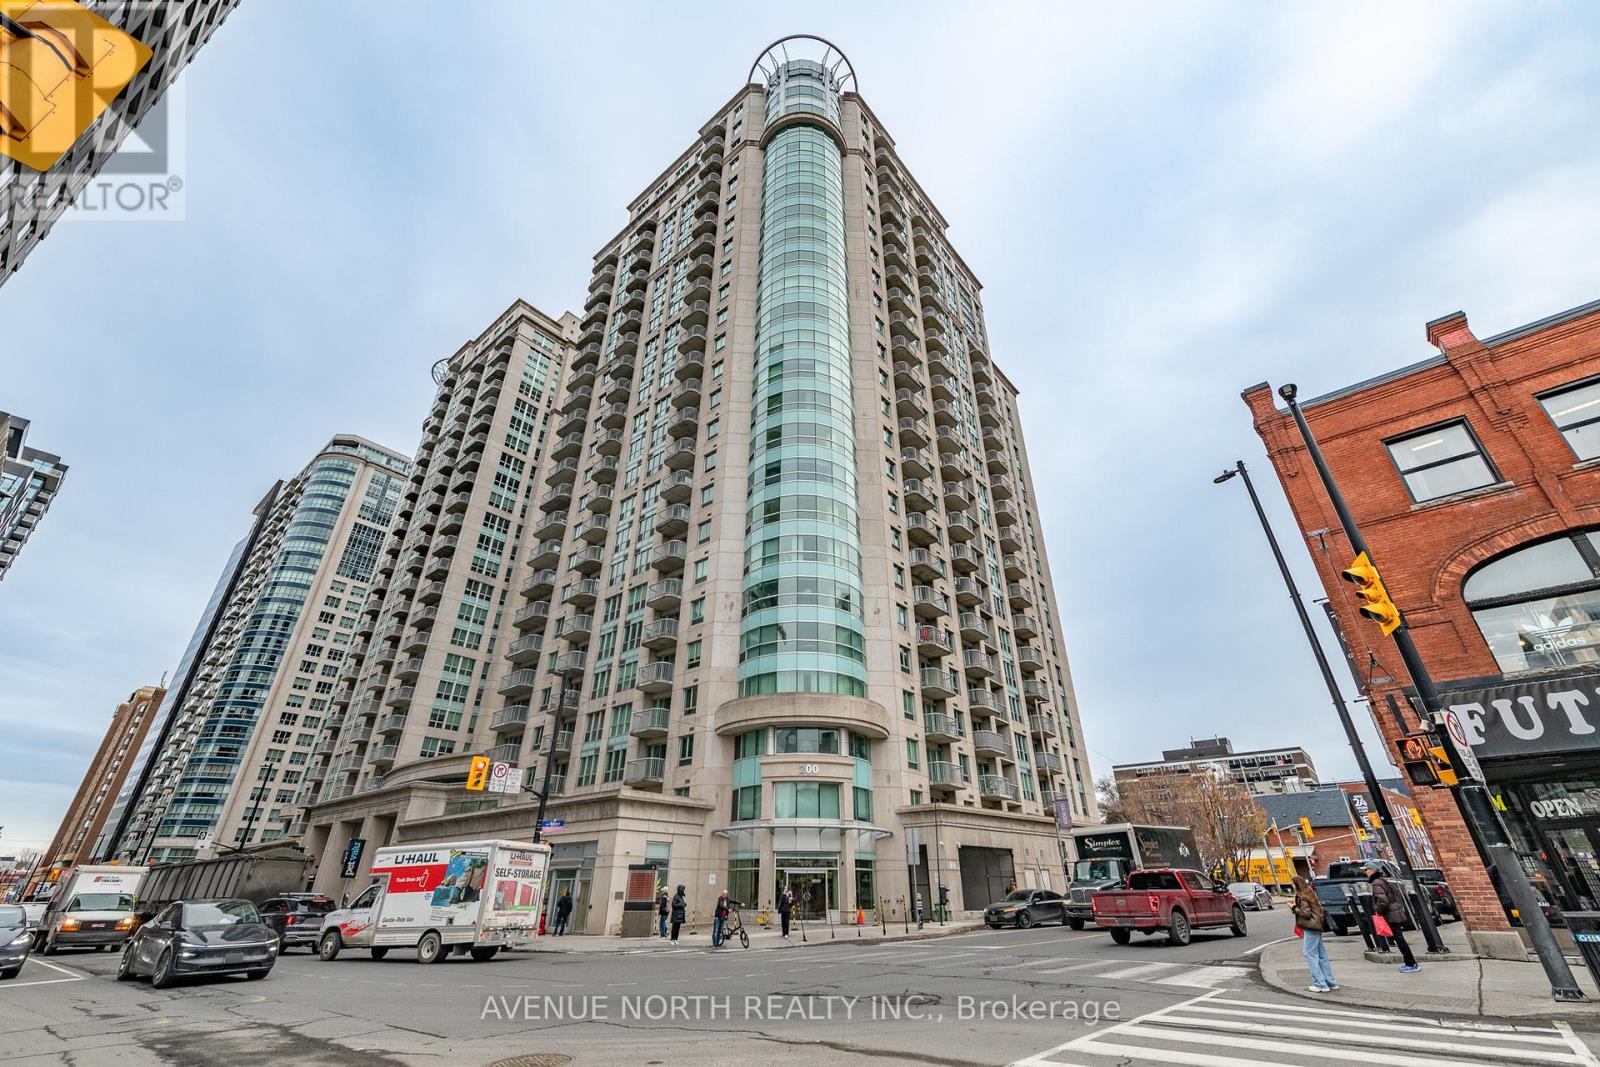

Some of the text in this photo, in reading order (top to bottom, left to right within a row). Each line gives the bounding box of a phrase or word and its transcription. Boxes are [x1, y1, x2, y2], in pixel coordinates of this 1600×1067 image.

[1533, 637, 1586, 653] adidas
[1449, 687, 1600, 746] FUT
[1530, 798, 1584, 818] OPEN
[1085, 838, 1121, 849] Simplex
[394, 852, 439, 864] U-HAUL
[510, 852, 533, 861] U-HAUL
[495, 867, 542, 879] SELF-STORAGE
